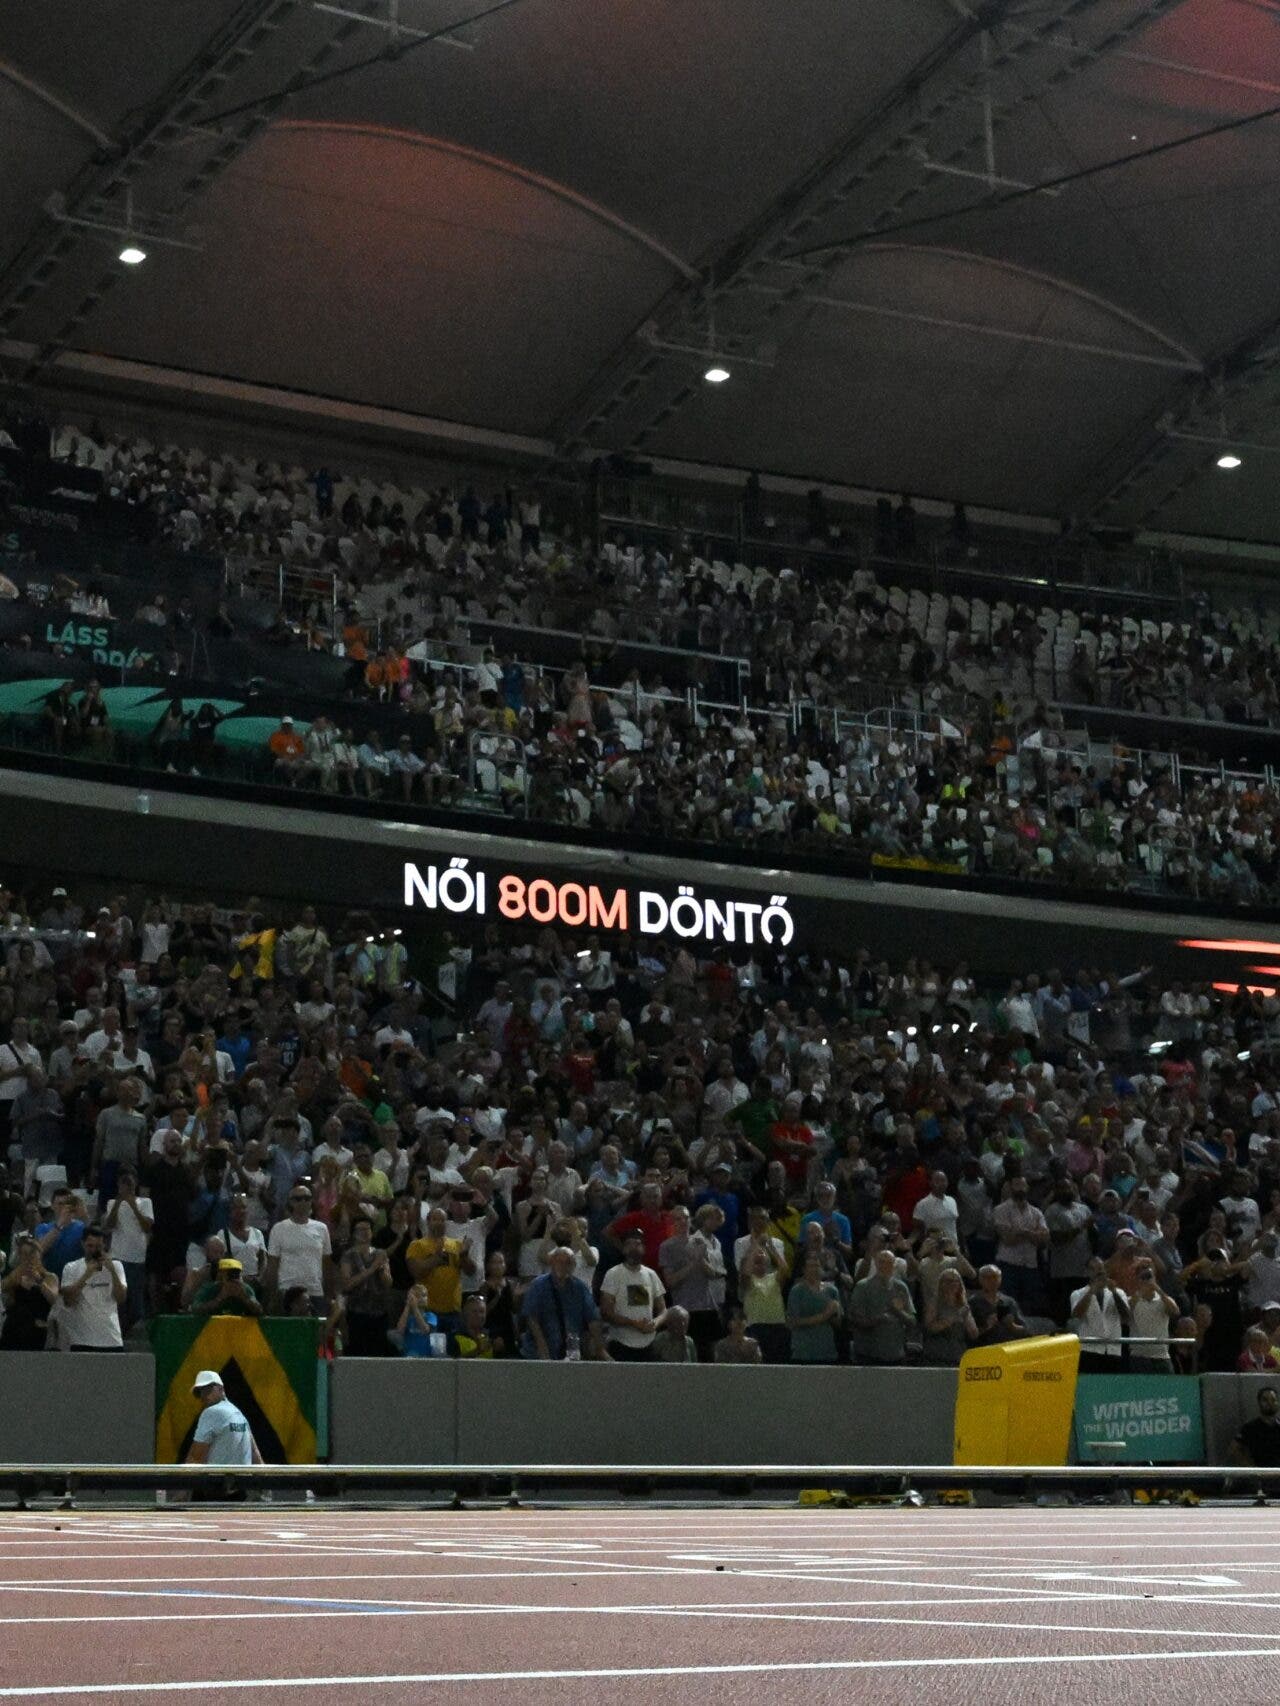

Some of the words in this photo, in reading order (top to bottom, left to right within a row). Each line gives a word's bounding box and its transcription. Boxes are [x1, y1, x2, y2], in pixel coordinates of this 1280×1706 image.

[46, 620, 109, 648] LÁSS
[403, 857, 486, 915] NŐI
[498, 874, 628, 932] 800M
[639, 884, 794, 947] DÖNTŐ
[965, 1365, 1003, 1382] SEIKO
[1092, 1397, 1179, 1421] WITNESS
[1105, 1414, 1192, 1439] WONDER
